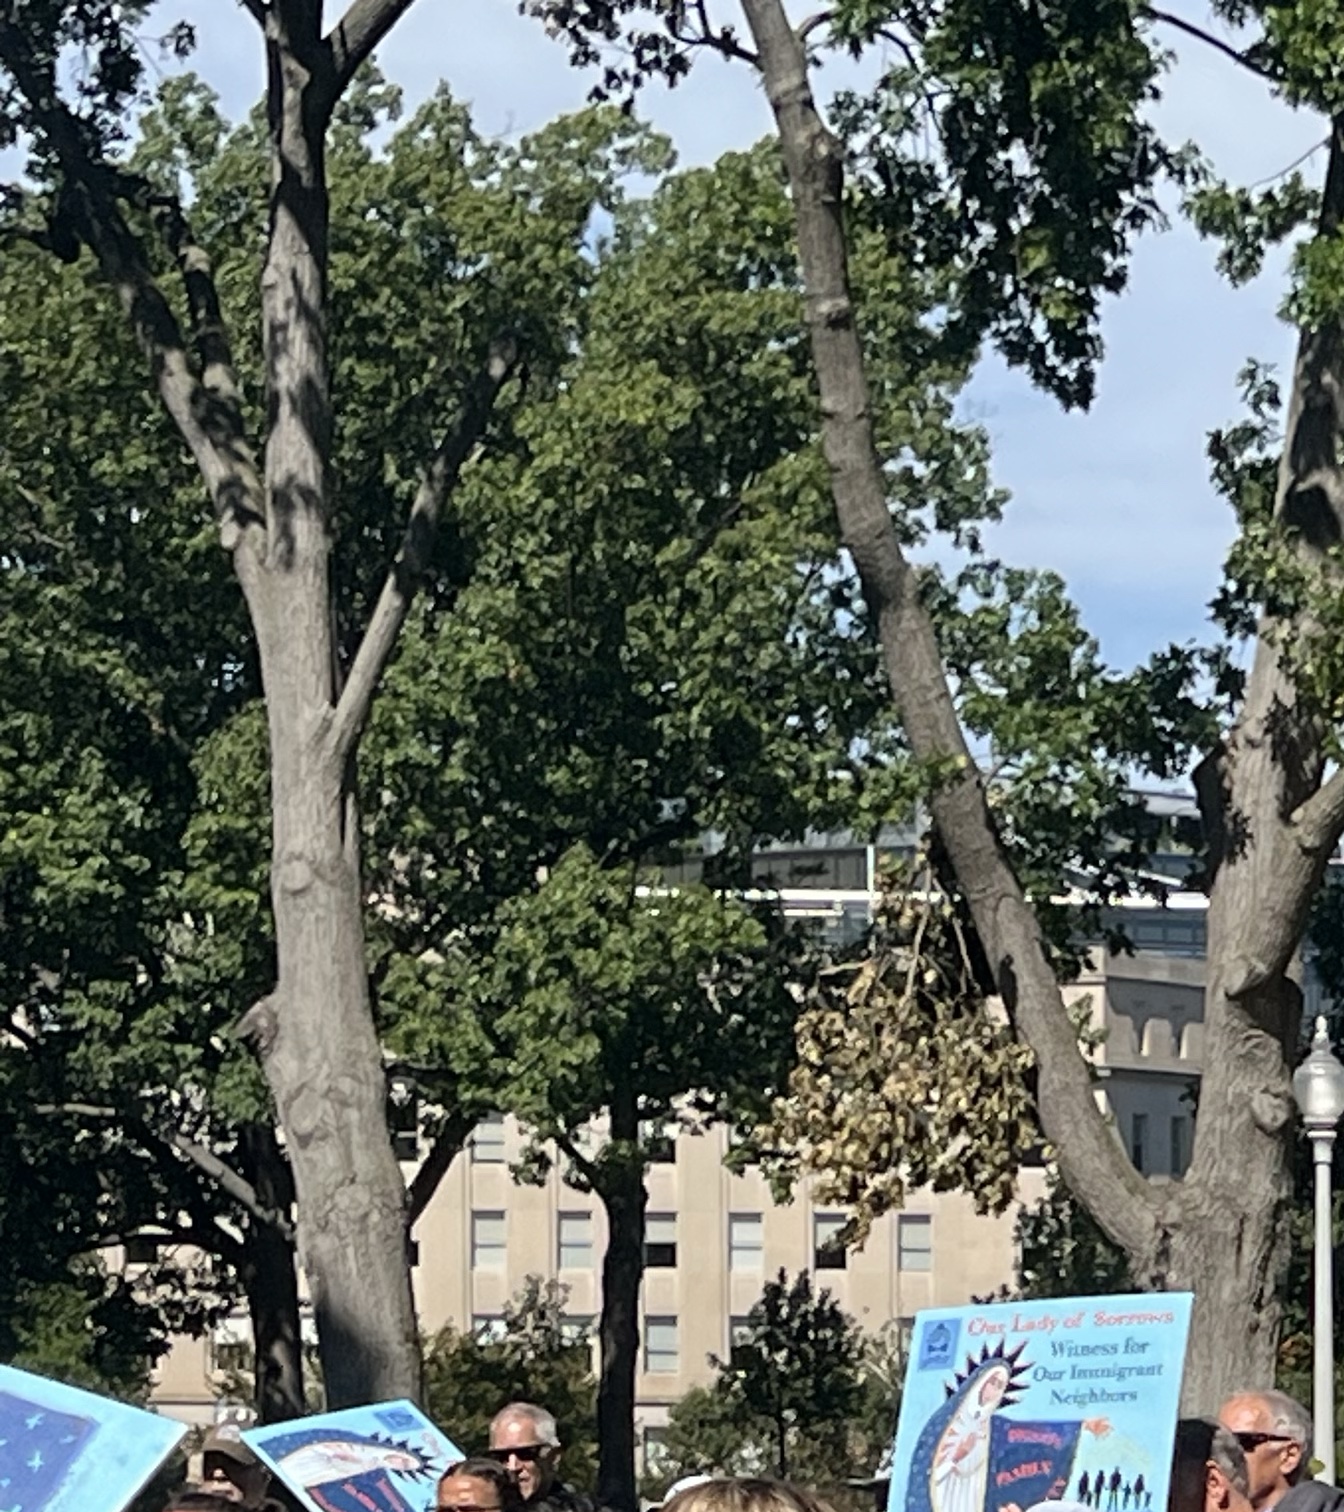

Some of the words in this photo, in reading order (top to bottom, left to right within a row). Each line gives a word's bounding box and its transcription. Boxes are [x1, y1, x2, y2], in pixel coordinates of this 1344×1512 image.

[968, 1317, 1005, 1336] Our
[1011, 1313, 1057, 1336] Lady
[1064, 1312, 1085, 1329] of
[1094, 1311, 1174, 1326] Sorrows
[1051, 1339, 1119, 1358] Witness
[1123, 1336, 1149, 1355] for
[1033, 1365, 1066, 1382] Our
[1070, 1361, 1163, 1381] Immigrant
[1050, 1388, 1138, 1408] Neighbors
